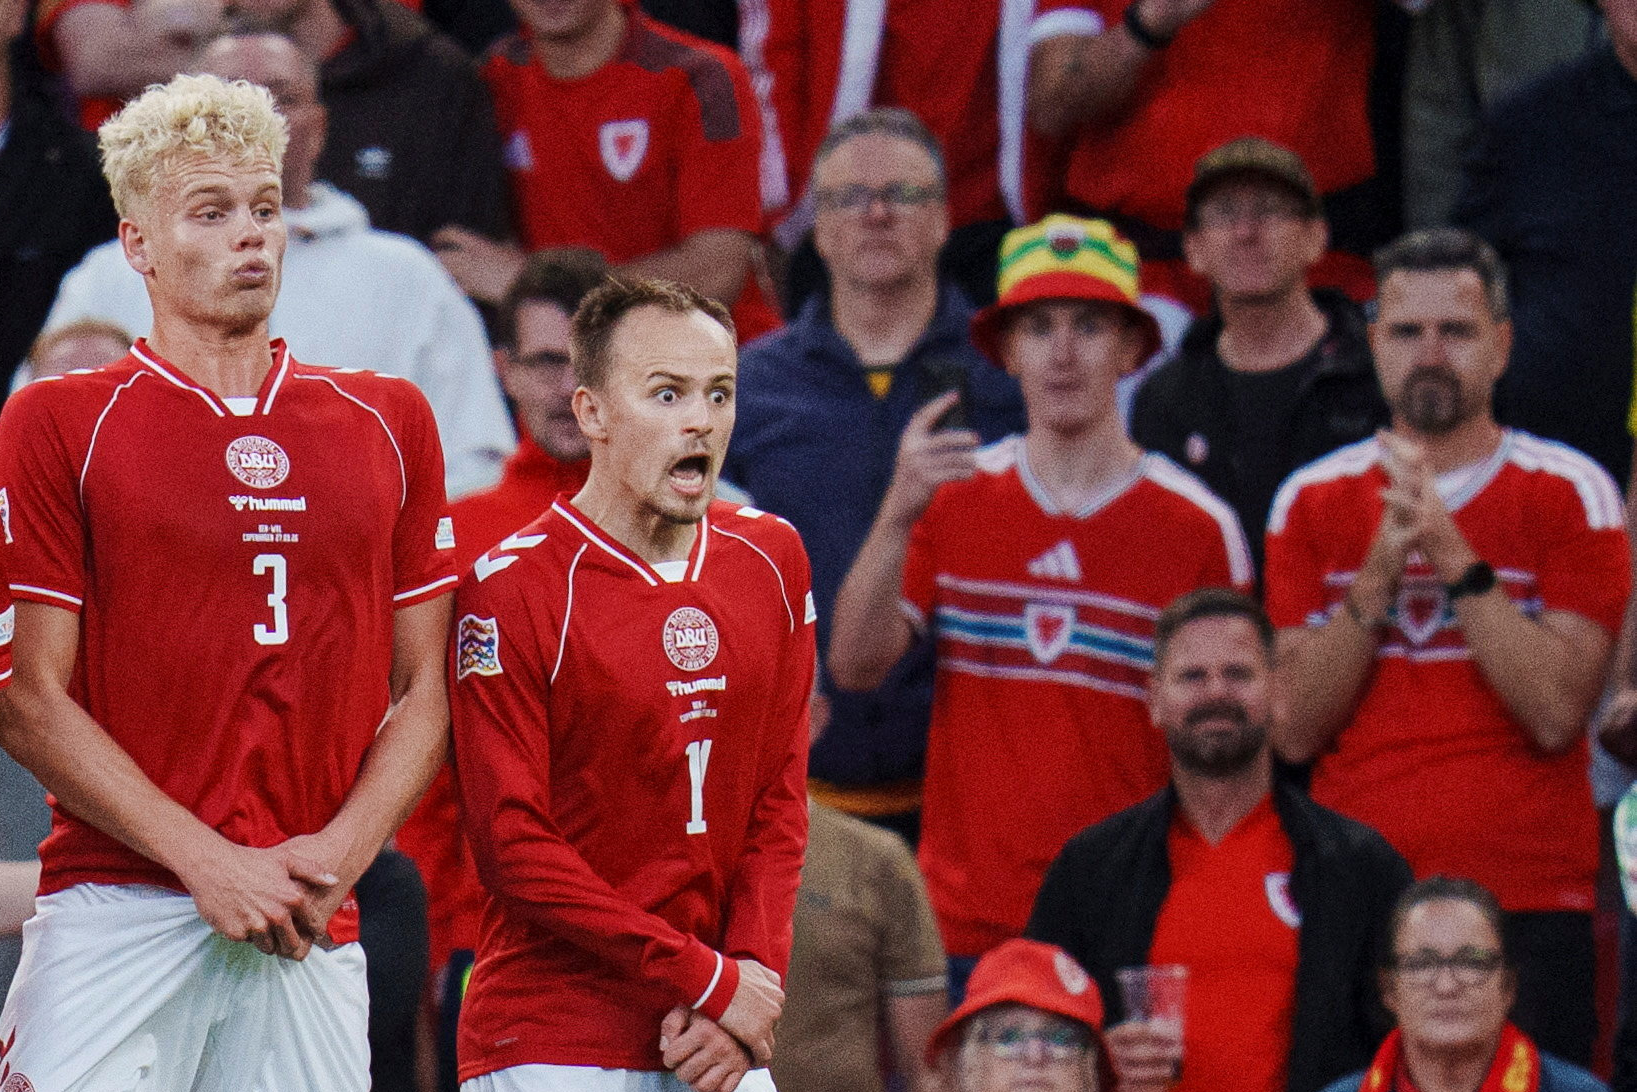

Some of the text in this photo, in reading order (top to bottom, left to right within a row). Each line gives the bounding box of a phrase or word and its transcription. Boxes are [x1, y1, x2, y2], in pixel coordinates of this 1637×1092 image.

[239, 453, 277, 470] DBU
[248, 496, 307, 511] hummel
[252, 553, 289, 646] 3
[675, 627, 707, 649] DBU
